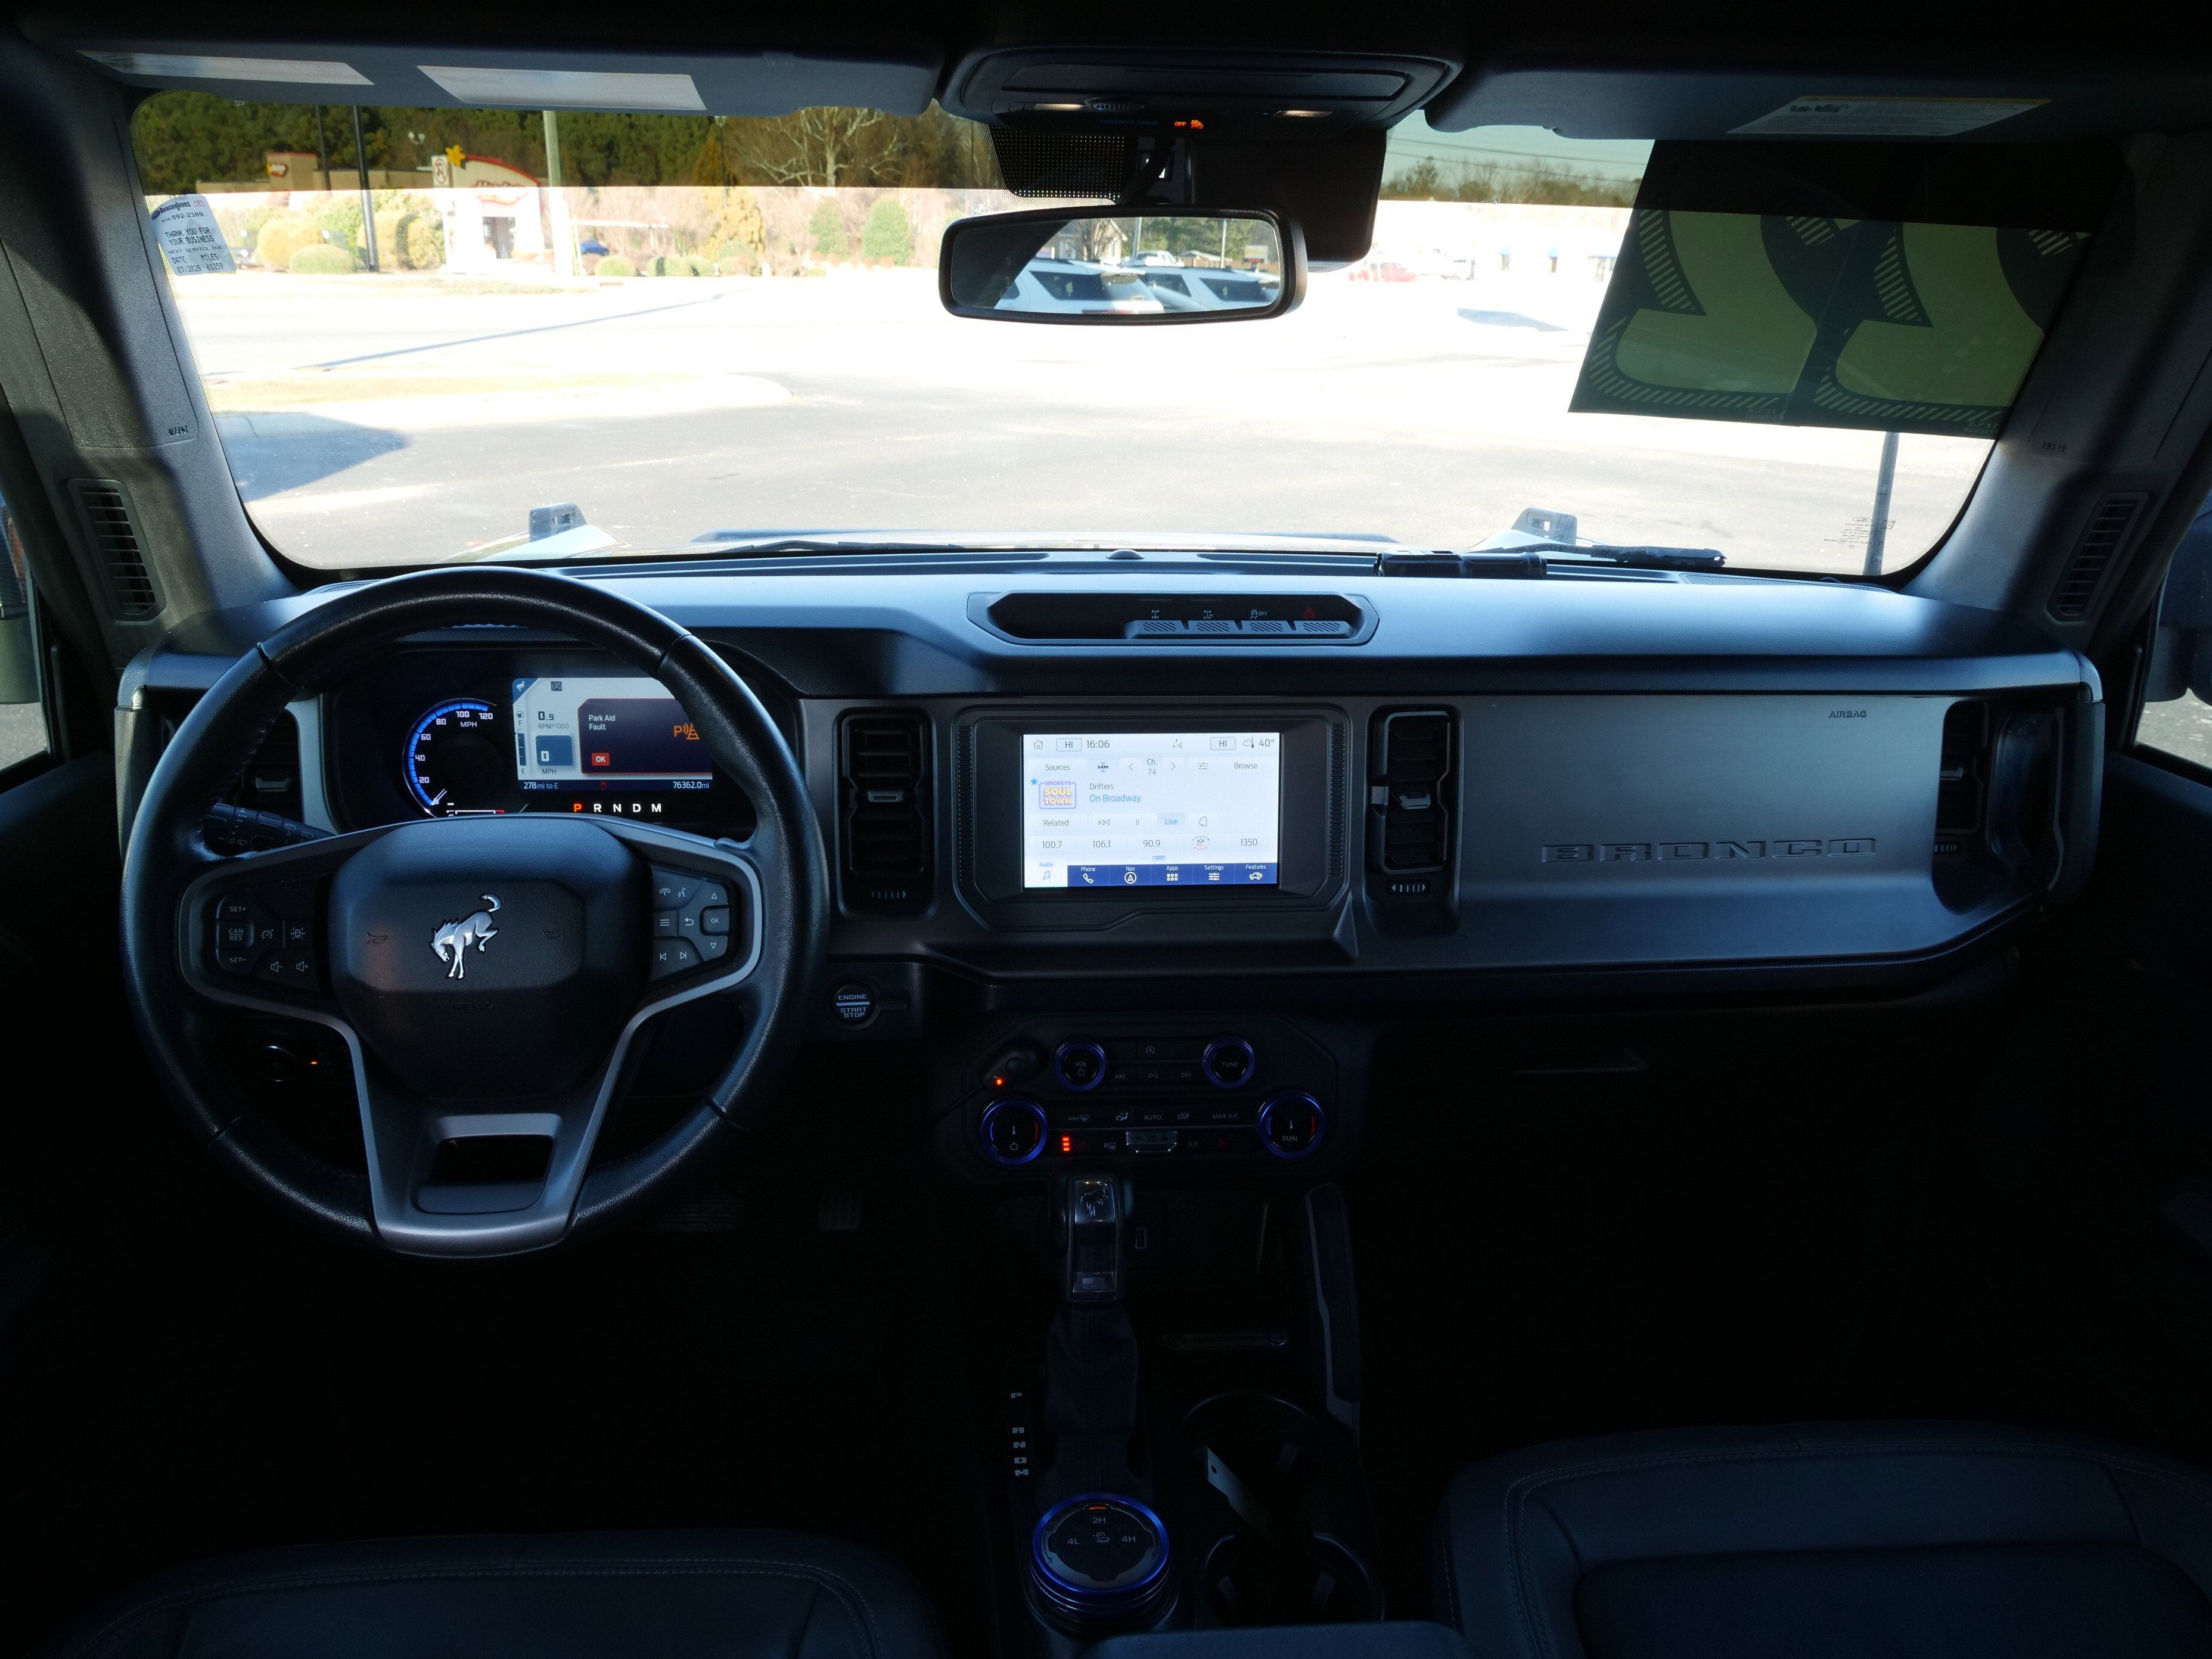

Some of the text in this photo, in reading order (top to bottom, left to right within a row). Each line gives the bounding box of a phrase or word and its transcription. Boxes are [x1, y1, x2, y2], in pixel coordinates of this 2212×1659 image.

[165, 229, 184, 238] THANK
[185, 228, 197, 236] YOU
[185, 235, 215, 244] BUSINESS
[1829, 710, 1868, 719] AIRBAG
[1086, 740, 1110, 748] 16:06
[1259, 738, 1275, 747] 40°
[540, 751, 549, 762] 0
[1043, 787, 1072, 797] SOUL
[1103, 794, 1141, 803] Broadway
[573, 804, 661, 812] P R N D M
[1542, 838, 1877, 863] BRONCO
